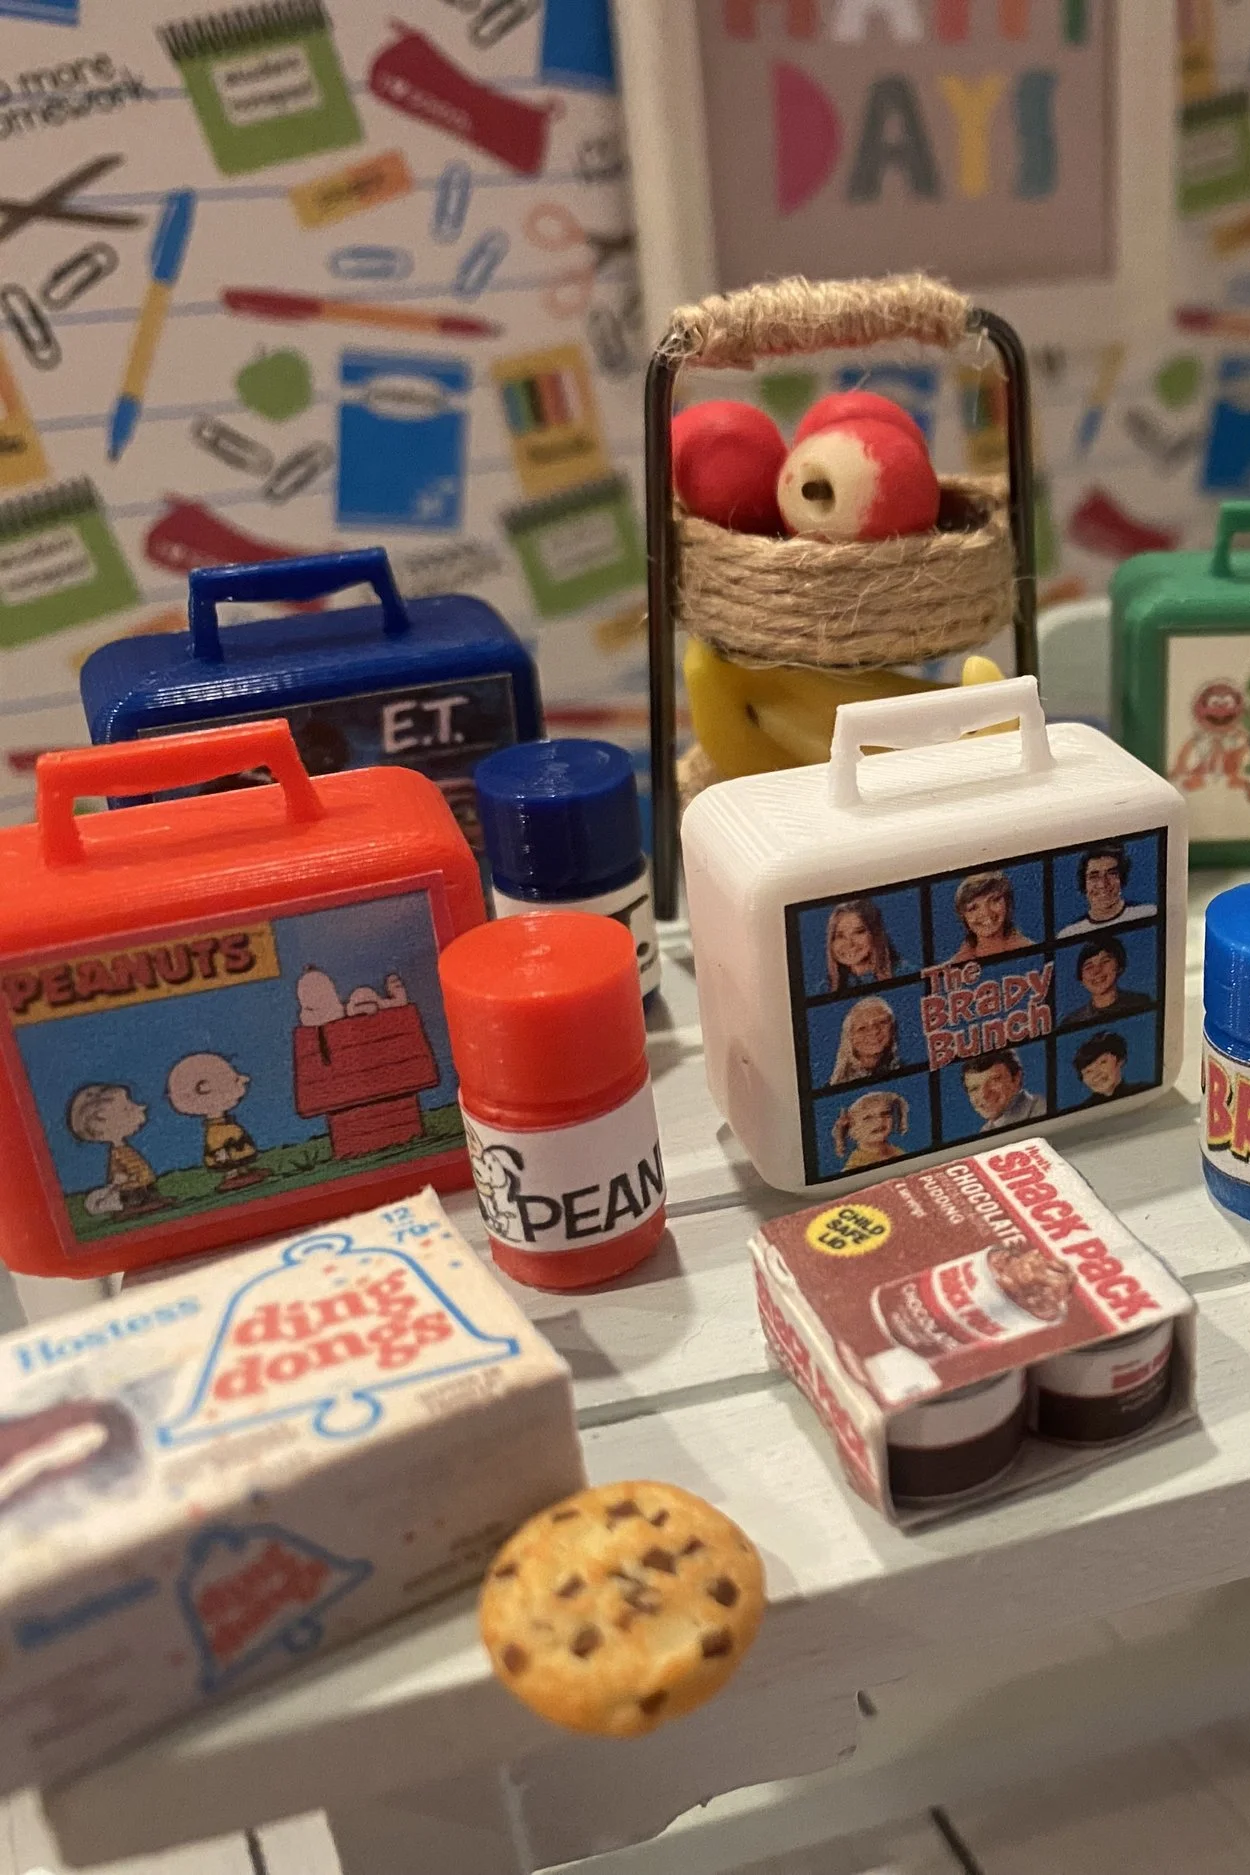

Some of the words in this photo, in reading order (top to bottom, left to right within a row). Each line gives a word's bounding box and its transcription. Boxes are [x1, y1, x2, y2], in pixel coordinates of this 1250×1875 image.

[382, 696, 470, 753] E.T.
[2, 932, 256, 1014] PEANUTS
[921, 961, 982, 994] The
[838, 1208, 886, 1236] CHILD
[919, 1175, 966, 1225] PUDDING
[945, 1164, 1028, 1250] CHOCOLATE
[825, 1219, 873, 1245] SAFE
[233, 1267, 418, 1347] ding
[212, 1310, 455, 1402] dongs
